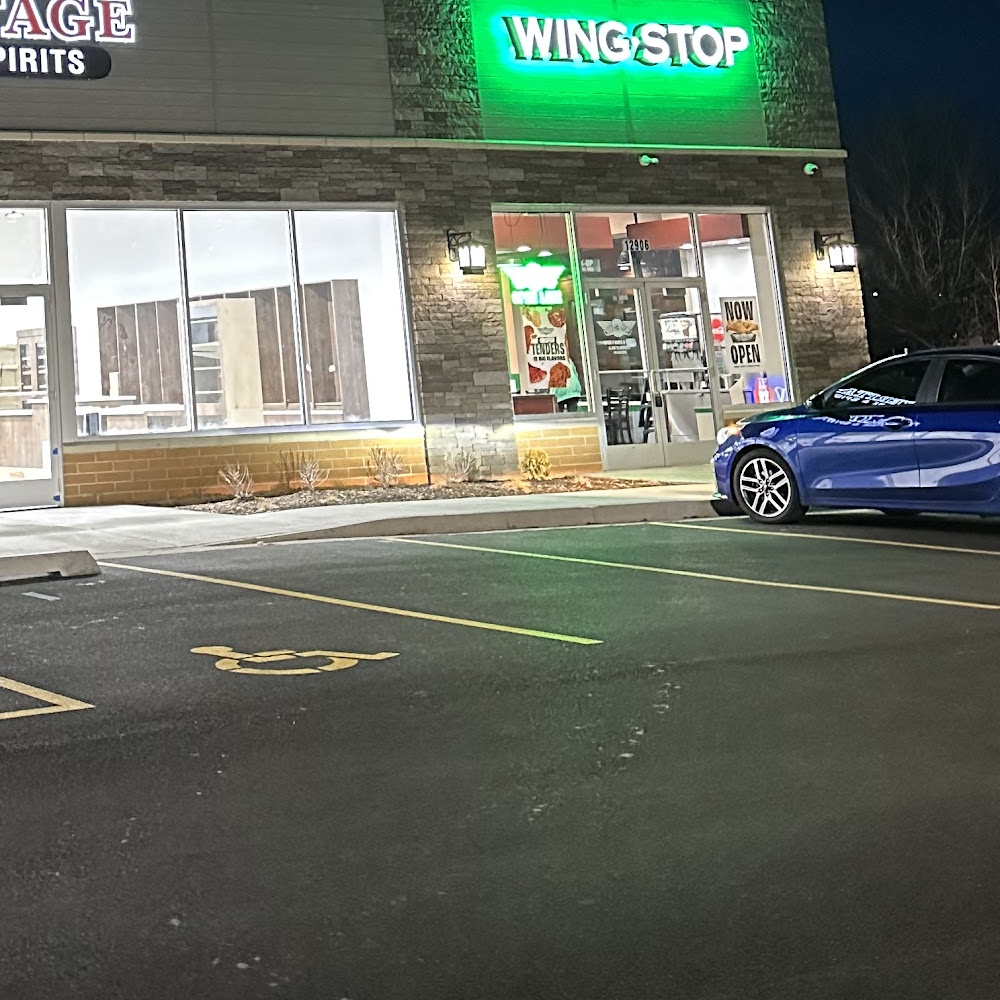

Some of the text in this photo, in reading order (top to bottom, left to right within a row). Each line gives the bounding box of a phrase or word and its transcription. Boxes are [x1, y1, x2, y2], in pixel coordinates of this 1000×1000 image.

[624, 239, 649, 251] 12906
[724, 300, 754, 321] NOW
[532, 343, 565, 355] TENDERS
[730, 343, 761, 365] OPEN
